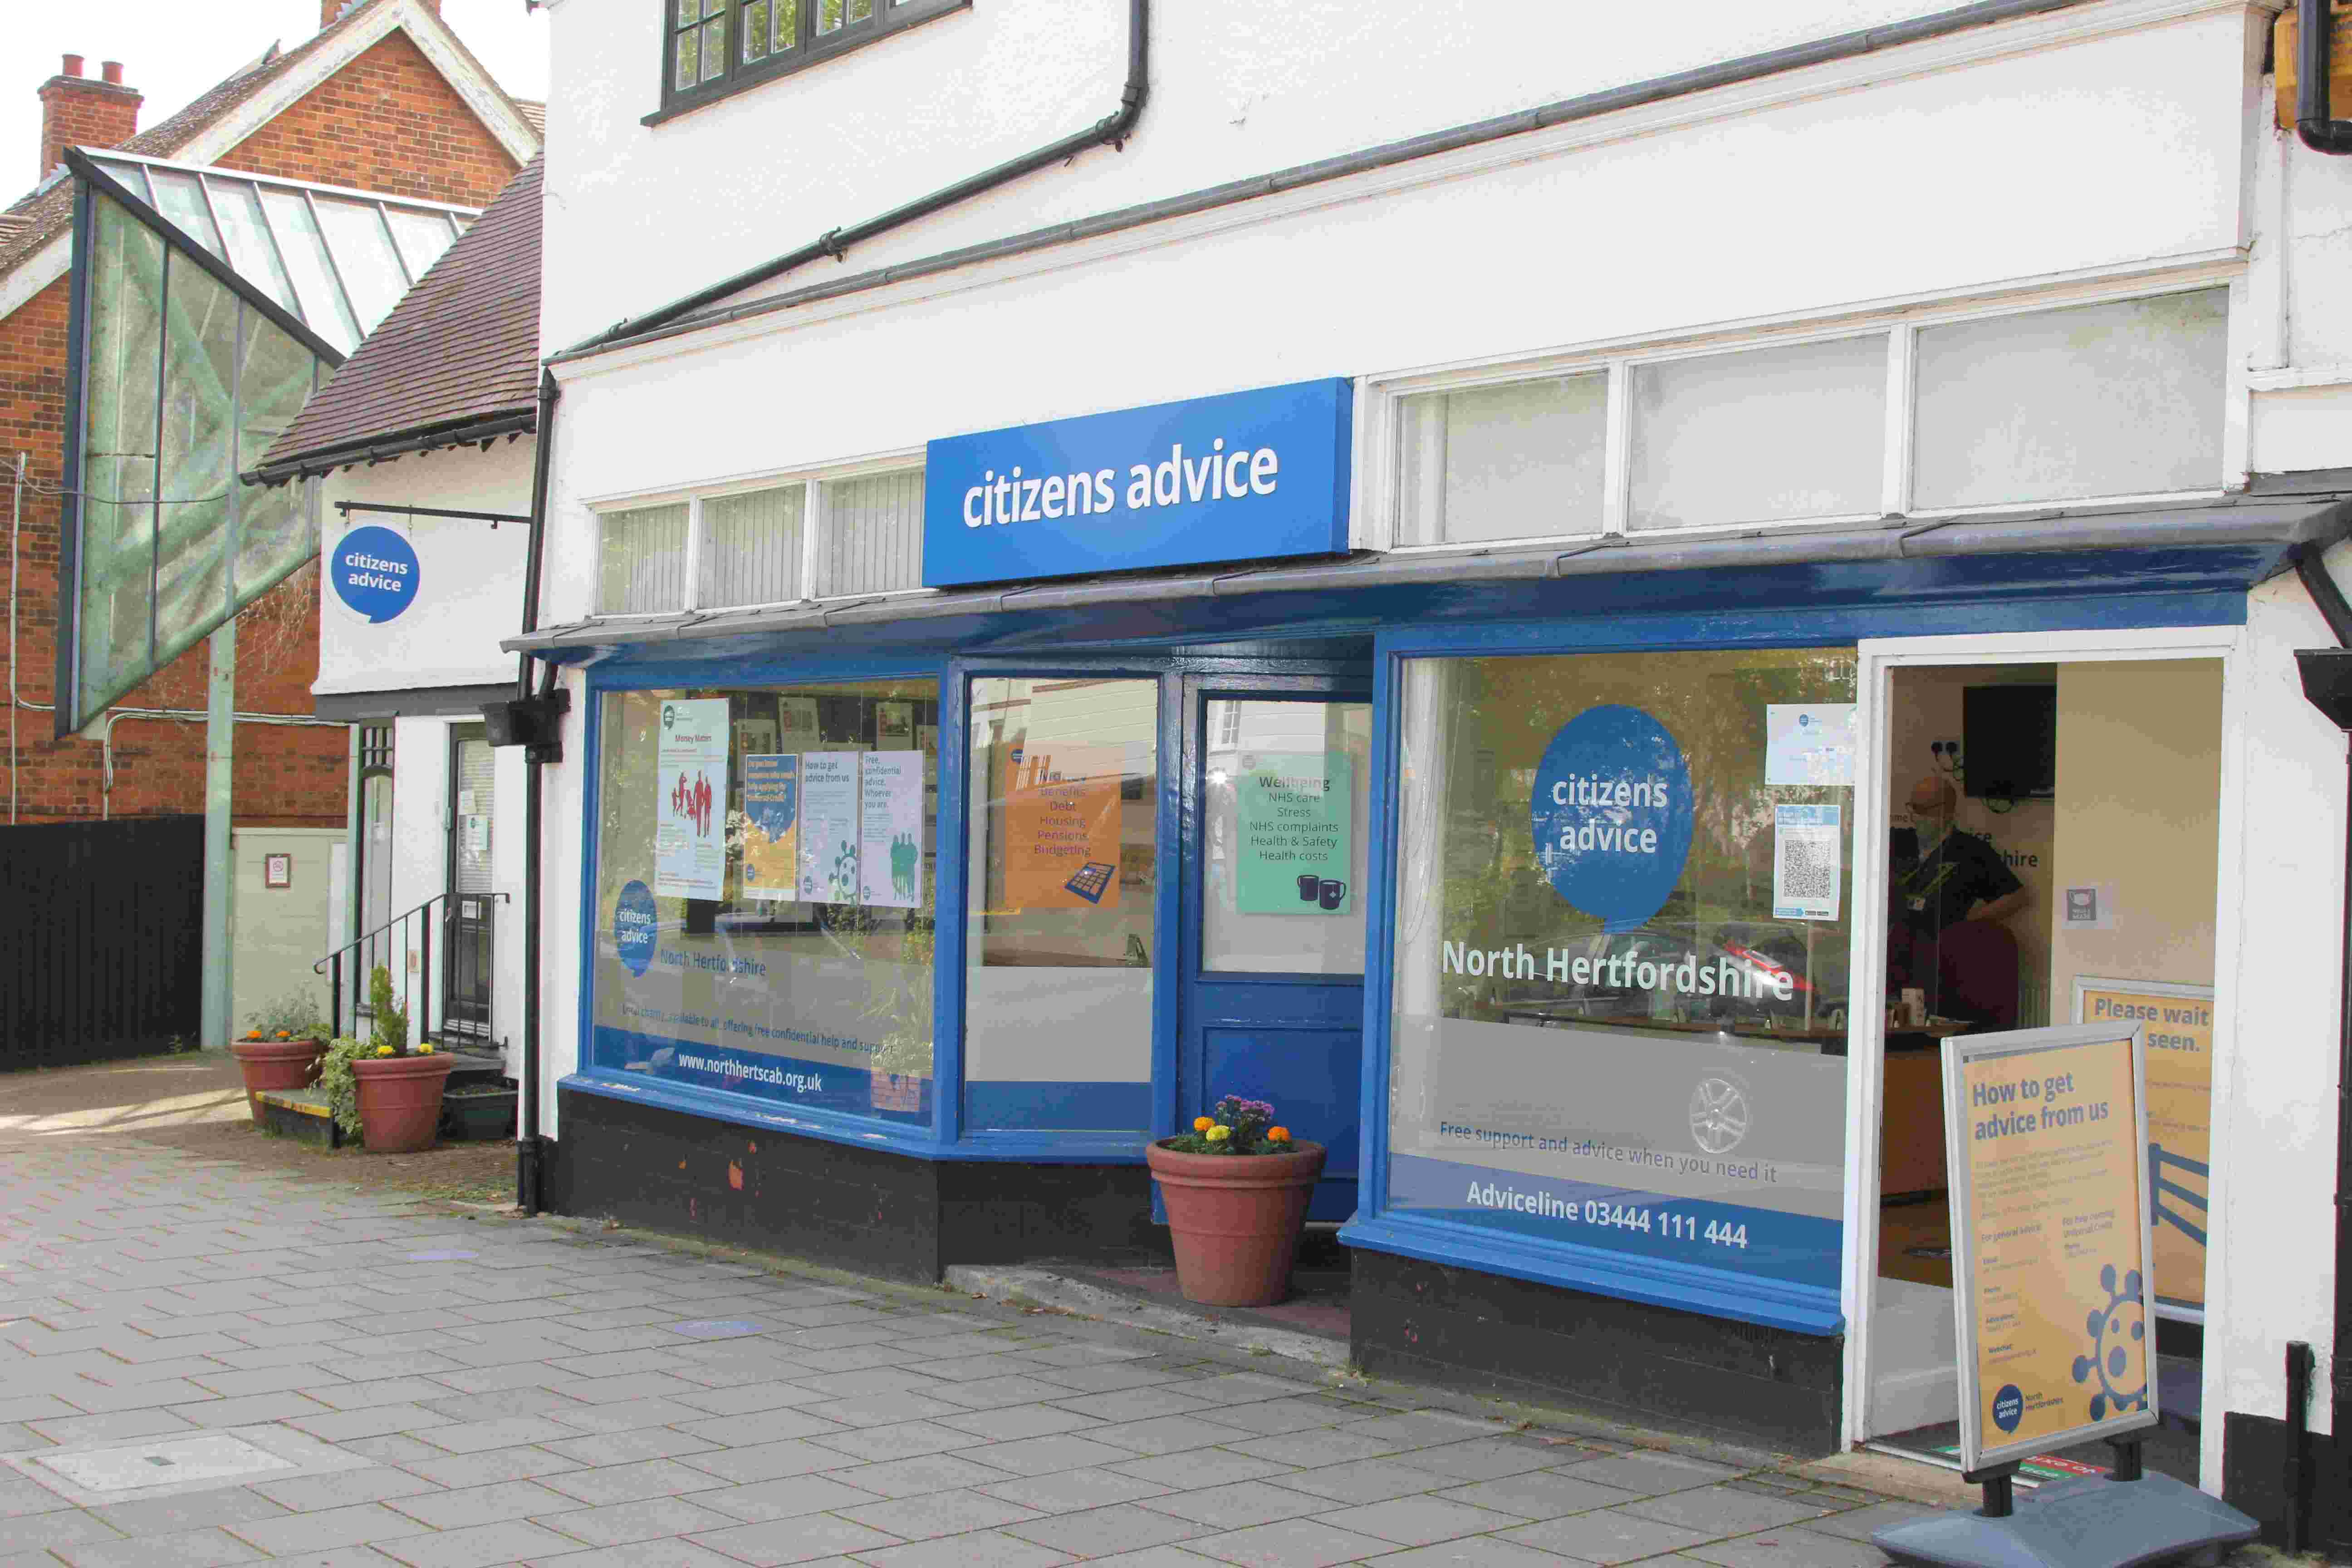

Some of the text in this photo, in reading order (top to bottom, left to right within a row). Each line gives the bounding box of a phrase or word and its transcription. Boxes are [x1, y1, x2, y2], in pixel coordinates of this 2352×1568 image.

[963, 438, 1278, 527] citizens advice
[345, 553, 408, 574] citizens
[348, 573, 401, 591] advice
[675, 734, 694, 745] Money
[805, 761, 818, 769] How
[828, 762, 837, 771] get
[865, 766, 901, 775] confidential
[805, 773, 849, 783] advice from us
[1259, 776, 1330, 792] Wellbeing
[865, 789, 891, 798] Whoever
[1040, 787, 1086, 797] Benefits
[1269, 793, 1293, 803] NHS
[1553, 773, 1668, 808] citizens
[864, 801, 875, 810] you
[1050, 800, 1076, 811] Debt
[1277, 807, 1311, 817] Stress
[1040, 816, 1086, 828] Housing
[1250, 821, 1339, 834] NHS complaints
[1038, 830, 1088, 839] Pensions
[1560, 818, 1657, 853] advice
[1251, 835, 1338, 850] Health & Safety
[1034, 844, 1091, 857] Budgeting
[1259, 850, 1328, 861] Health costs
[619, 908, 651, 925] citizens
[621, 929, 648, 944] advice
[660, 948, 690, 968] North
[1442, 941, 1793, 1001] North Hertfordshire
[2095, 998, 2209, 1026] Please wait
[723, 1019, 753, 1038] offering
[755, 1023, 769, 1038] free
[771, 1027, 818, 1045] confidential
[820, 1034, 839, 1051] help
[842, 1038, 858, 1050] and
[2148, 1033, 2200, 1052] seen.
[678, 1053, 823, 1093] www.northhertscab.org.uk
[1973, 1072, 2074, 1107] How to get
[1975, 1102, 2109, 1140] advice from us
[1441, 1121, 1777, 1183] Free support and advice when you need it
[1467, 1181, 1748, 1249] Adviceline 03444 111 444
[1981, 1233, 1993, 1242] For
[1994, 1226, 2018, 1241] general
[1997, 1398, 2019, 1410] citizens
[2026, 1392, 2043, 1401] North
[1999, 1408, 2018, 1419] advice
